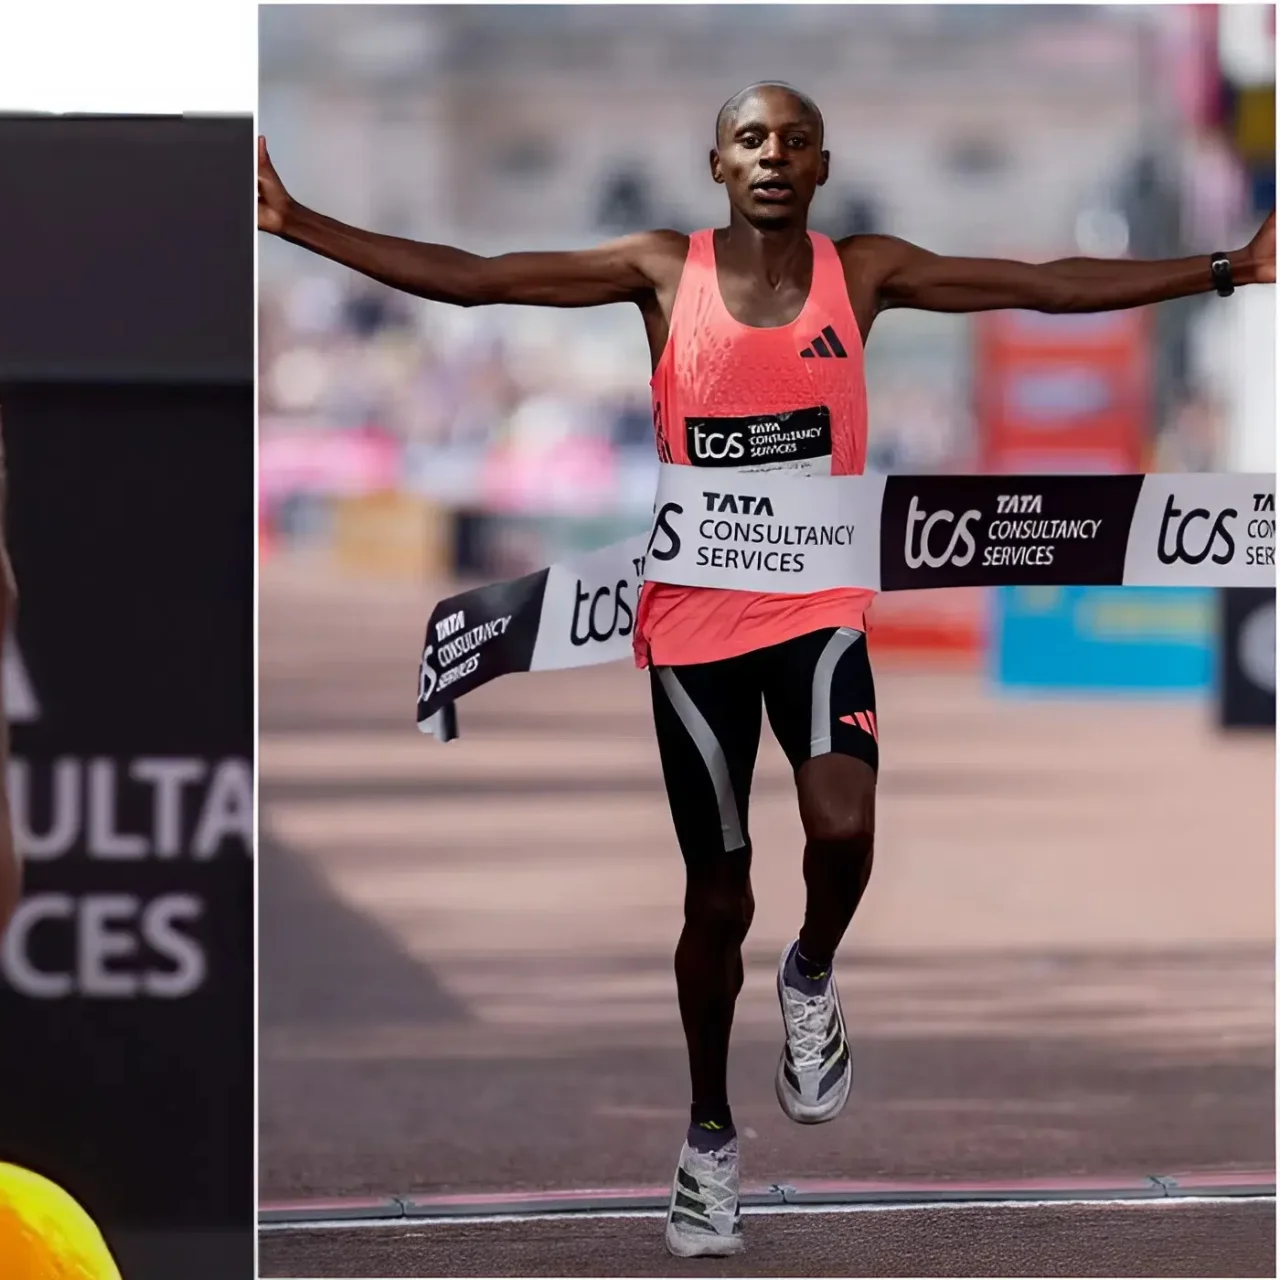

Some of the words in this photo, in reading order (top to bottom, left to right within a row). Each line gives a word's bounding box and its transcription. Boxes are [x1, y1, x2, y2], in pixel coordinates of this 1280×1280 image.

[693, 424, 745, 459] tcs
[702, 491, 774, 517] TATA
[996, 494, 1043, 514] TATA
[699, 519, 855, 545] CONSULTANCY
[904, 495, 982, 569] tcs
[988, 519, 1102, 540] CONSULTANCY
[1157, 493, 1238, 565] tcs
[696, 546, 805, 573] SERVICES
[982, 545, 1055, 566] SERVICES
[570, 579, 633, 646] tcs
